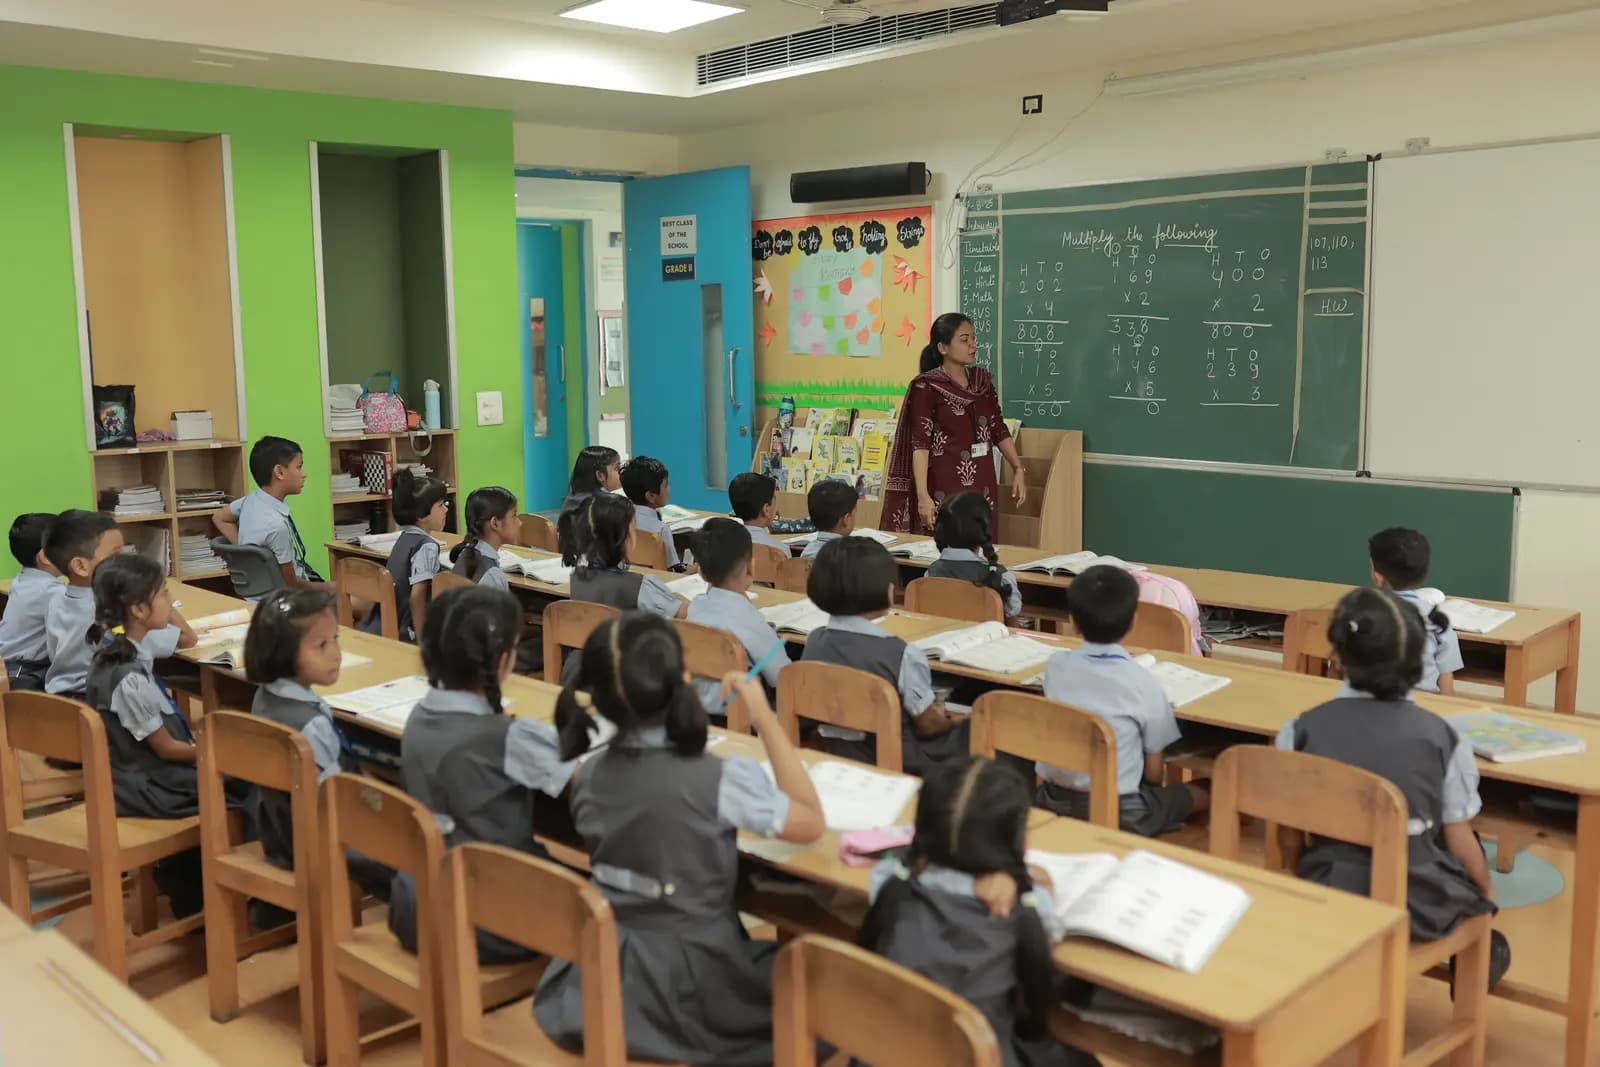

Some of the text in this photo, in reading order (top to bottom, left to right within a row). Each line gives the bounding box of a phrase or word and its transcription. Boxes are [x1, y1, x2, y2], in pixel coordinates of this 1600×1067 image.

[808, 232, 820, 250] fly
[1062, 230, 1114, 257] Multiply
[1125, 226, 1144, 242] the
[1153, 224, 1218, 253] following
[665, 264, 688, 273] GRADE
[1312, 256, 1328, 271] 113
[976, 274, 995, 288] Hindi
